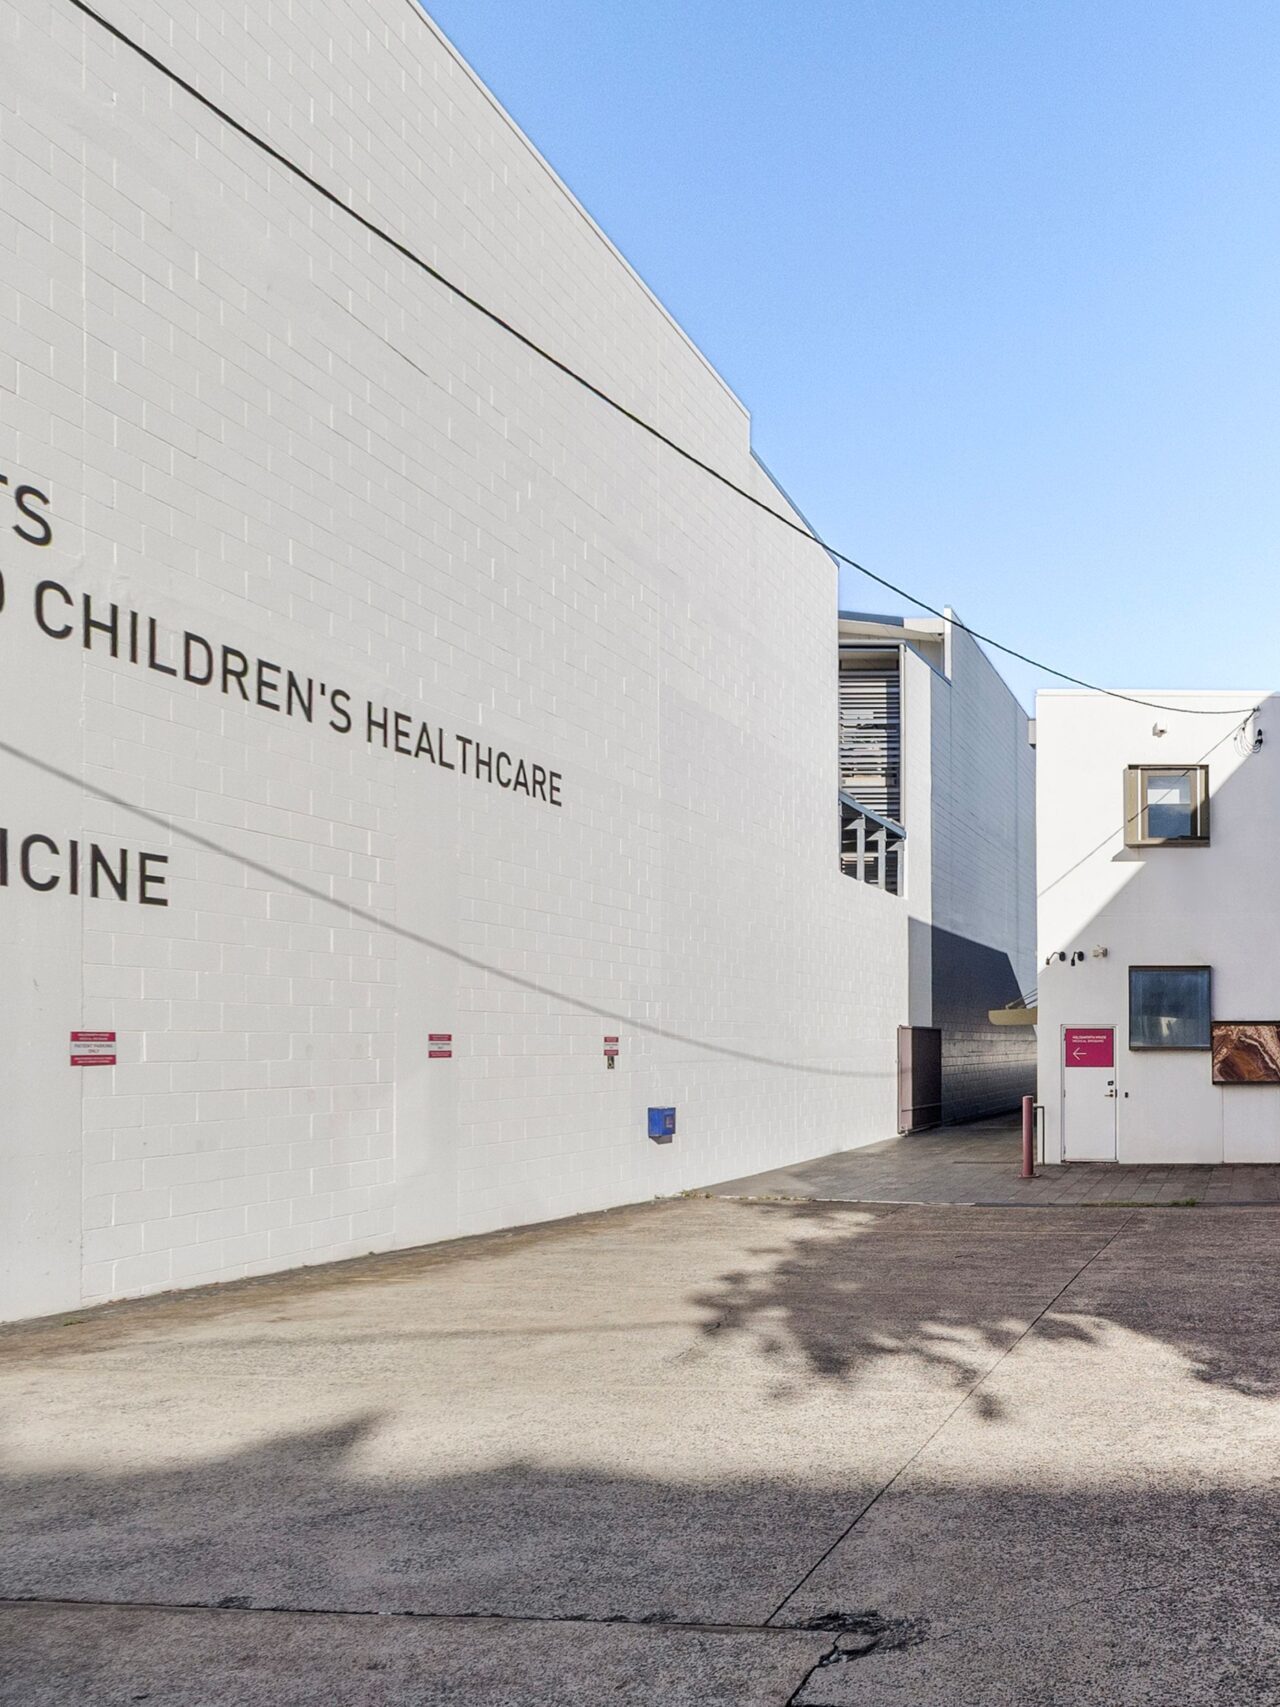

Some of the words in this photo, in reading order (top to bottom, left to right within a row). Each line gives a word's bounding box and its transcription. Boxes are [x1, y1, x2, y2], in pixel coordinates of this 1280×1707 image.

[0, 474, 52, 546] S
[35, 580, 352, 734] CHILDREN'S
[367, 701, 562, 807] HEALTHCARE
